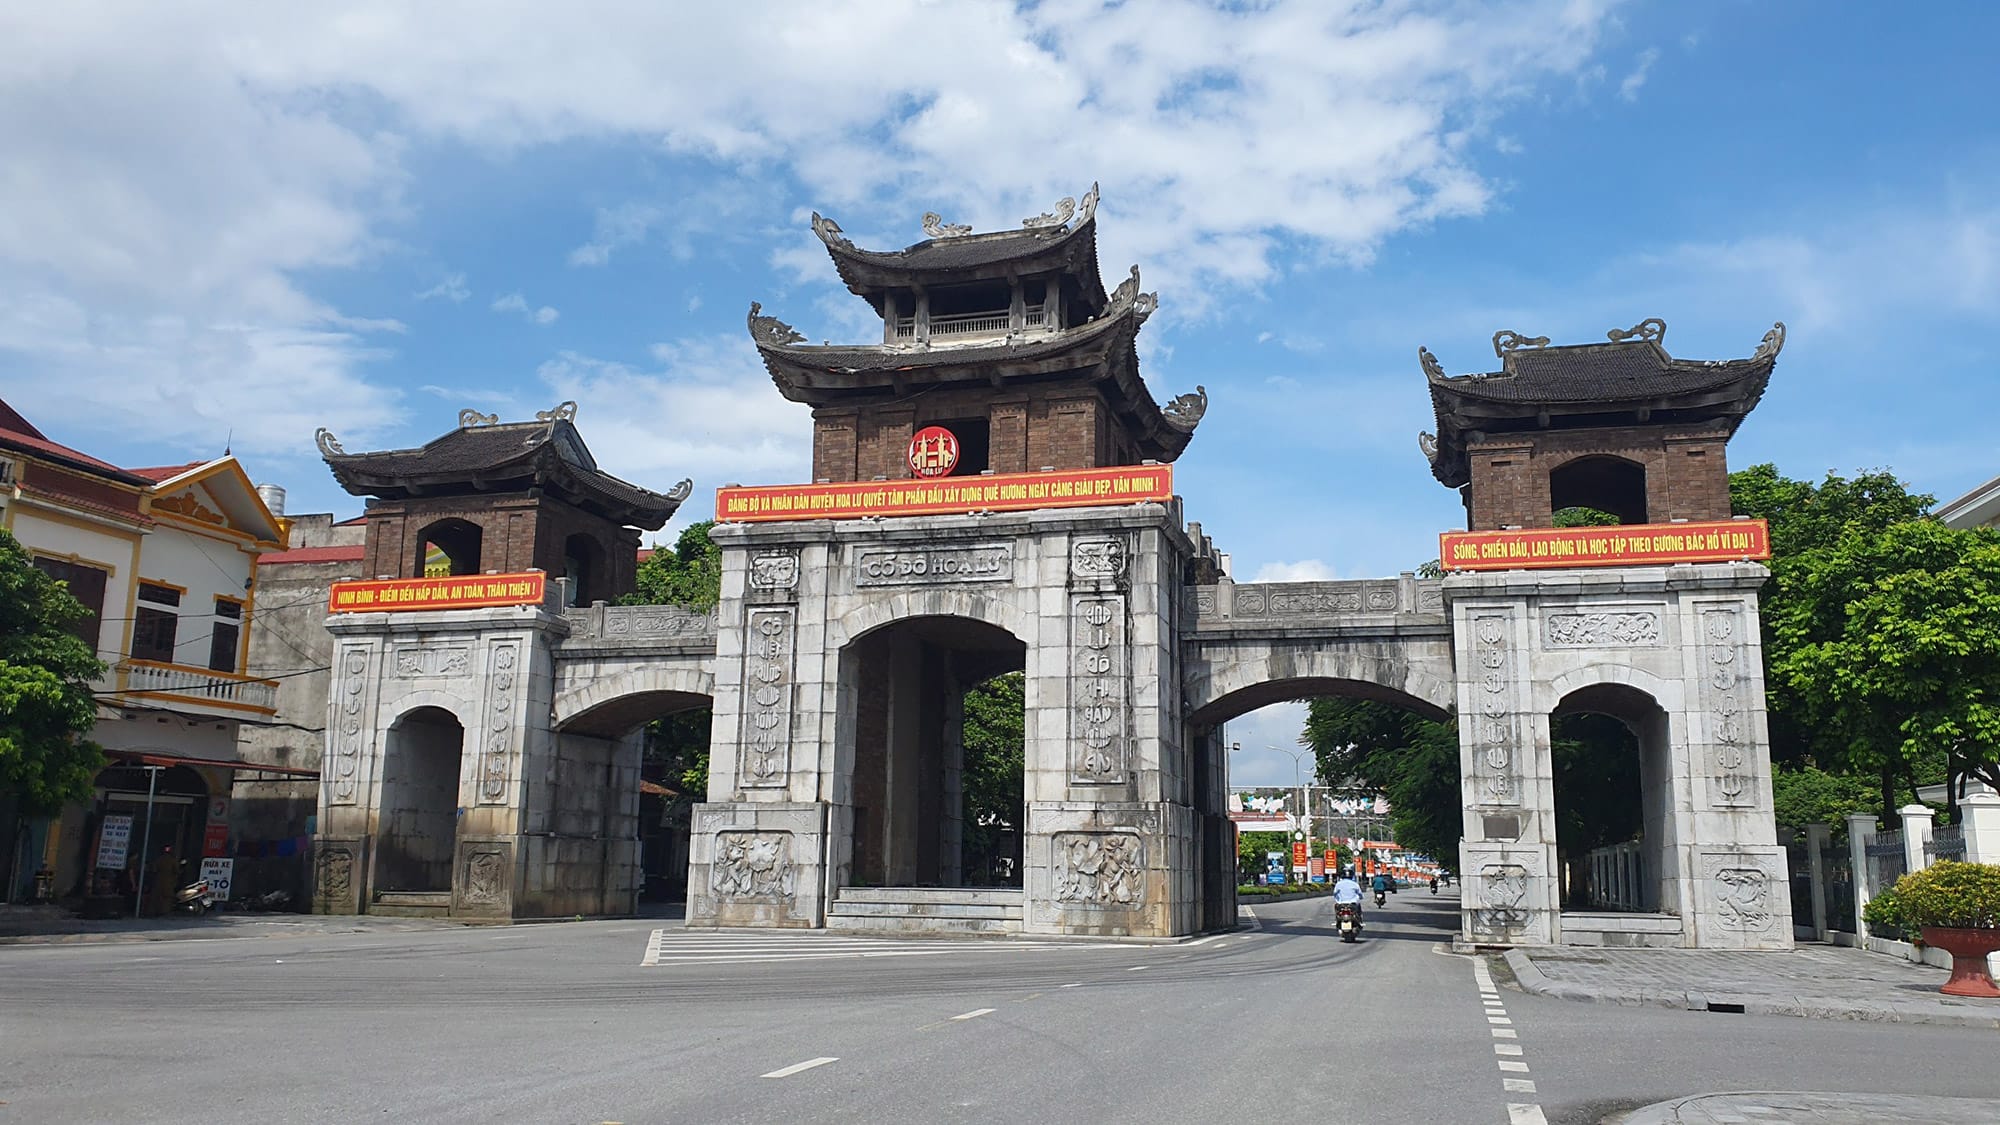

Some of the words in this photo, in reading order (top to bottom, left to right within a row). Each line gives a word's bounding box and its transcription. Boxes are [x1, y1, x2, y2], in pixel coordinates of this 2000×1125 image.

[728, 494, 747, 512] ĐẢNG
[749, 495, 759, 514] BỘ
[761, 494, 771, 511] VÀ
[772, 493, 792, 510] NHÂN
[794, 492, 809, 510] DÂN
[810, 492, 835, 511] HUYỆN
[836, 493, 851, 508] HOA
[852, 492, 863, 507] LƯ
[863, 488, 886, 506] QUYẾT
[887, 488, 904, 505] TÂM
[905, 485, 926, 504] PHẤN
[927, 484, 943, 503] ĐẤU
[944, 485, 960, 503] XÂY
[961, 486, 982, 504] DỰNG
[983, 483, 999, 501] QUÊ
[1000, 483, 1027, 500] HƯƠNG
[1028, 480, 1050, 499] NGÀY
[1051, 480, 1073, 497] CÀNG
[1074, 478, 1093, 496] GIÀU
[1095, 479, 1112, 499] ĐẸP,
[1113, 476, 1130, 493] VĂN
[1131, 477, 1153, 493] MINH
[1453, 537, 1480, 560] SỐNG,
[1482, 538, 1508, 558] CHIẾN
[1510, 537, 1530, 558] ĐẤU,
[1531, 541, 1548, 556] LAO
[1550, 537, 1574, 559] ĐỘNG
[1575, 536, 1588, 555] VÀ
[1590, 538, 1608, 557] HỌC
[1609, 535, 1627, 557] TẬP
[1628, 537, 1651, 553] THEO
[1653, 534, 1684, 552] GƯƠNG
[1686, 532, 1705, 551] BÁC
[1706, 528, 1719, 550] HỒ
[1720, 531, 1731, 549] VĨ
[1732, 533, 1748, 552] ĐẠI
[900, 558, 927, 576] ĐÔ
[932, 558, 972, 575] HOA
[975, 555, 1004, 573] LƯ
[337, 592, 356, 604] NINH
[356, 589, 374, 603] BÌNH
[379, 585, 398, 602] ĐIỂM
[400, 585, 415, 601] ĐẾN
[416, 584, 431, 600] HẤP
[450, 586, 462, 599] AN
[463, 583, 485, 599] TOÀN,
[487, 582, 507, 597] THÂN
[508, 580, 531, 598] THIỆN
[1086, 605, 1112, 626] HOA
[1088, 629, 1111, 650] LƯ
